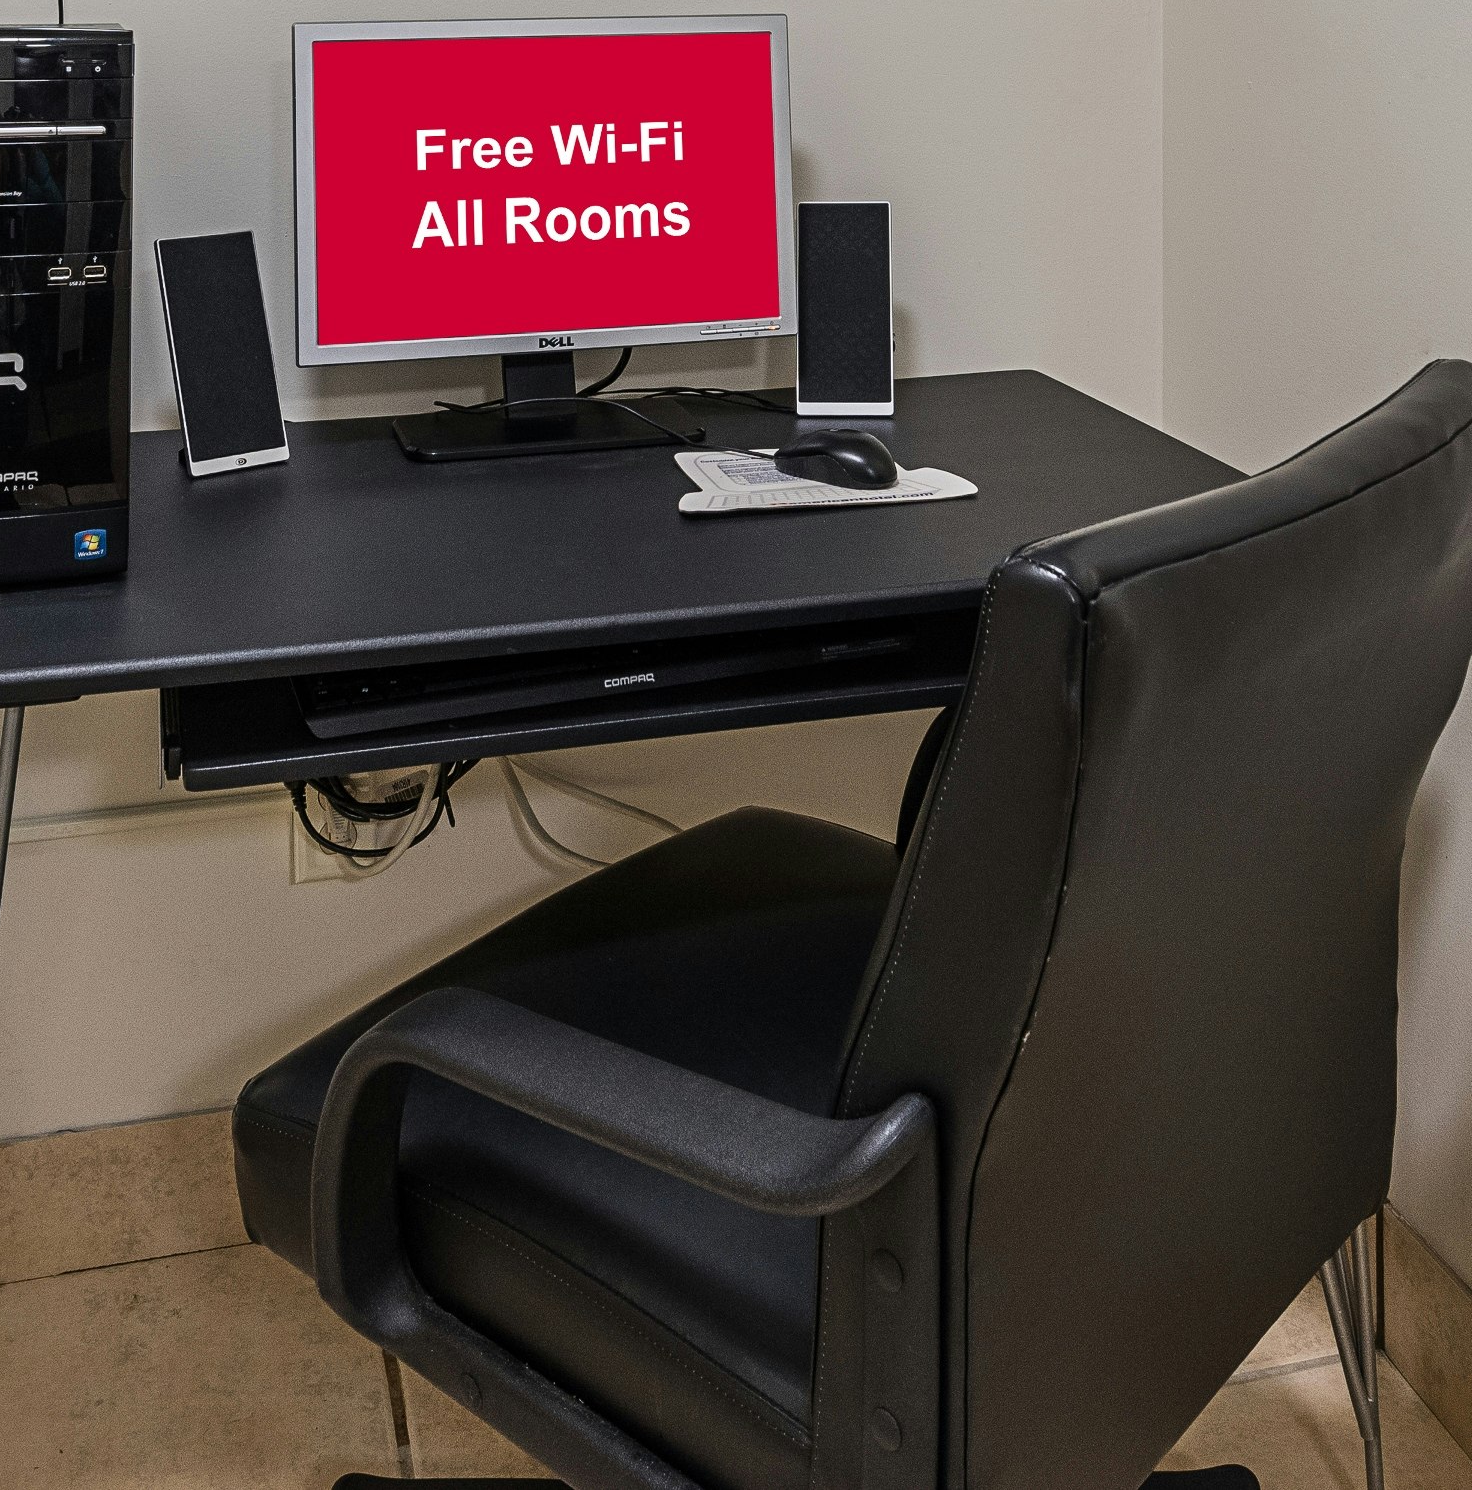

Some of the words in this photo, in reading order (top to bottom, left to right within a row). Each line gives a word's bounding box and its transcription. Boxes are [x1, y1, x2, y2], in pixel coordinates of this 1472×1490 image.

[416, 129, 534, 170] Free
[550, 121, 684, 165] Wi-Fi
[412, 199, 484, 248] All
[505, 197, 691, 245] Rooms
[538, 335, 575, 349] DELL
[604, 673, 656, 688] COMPAQ
